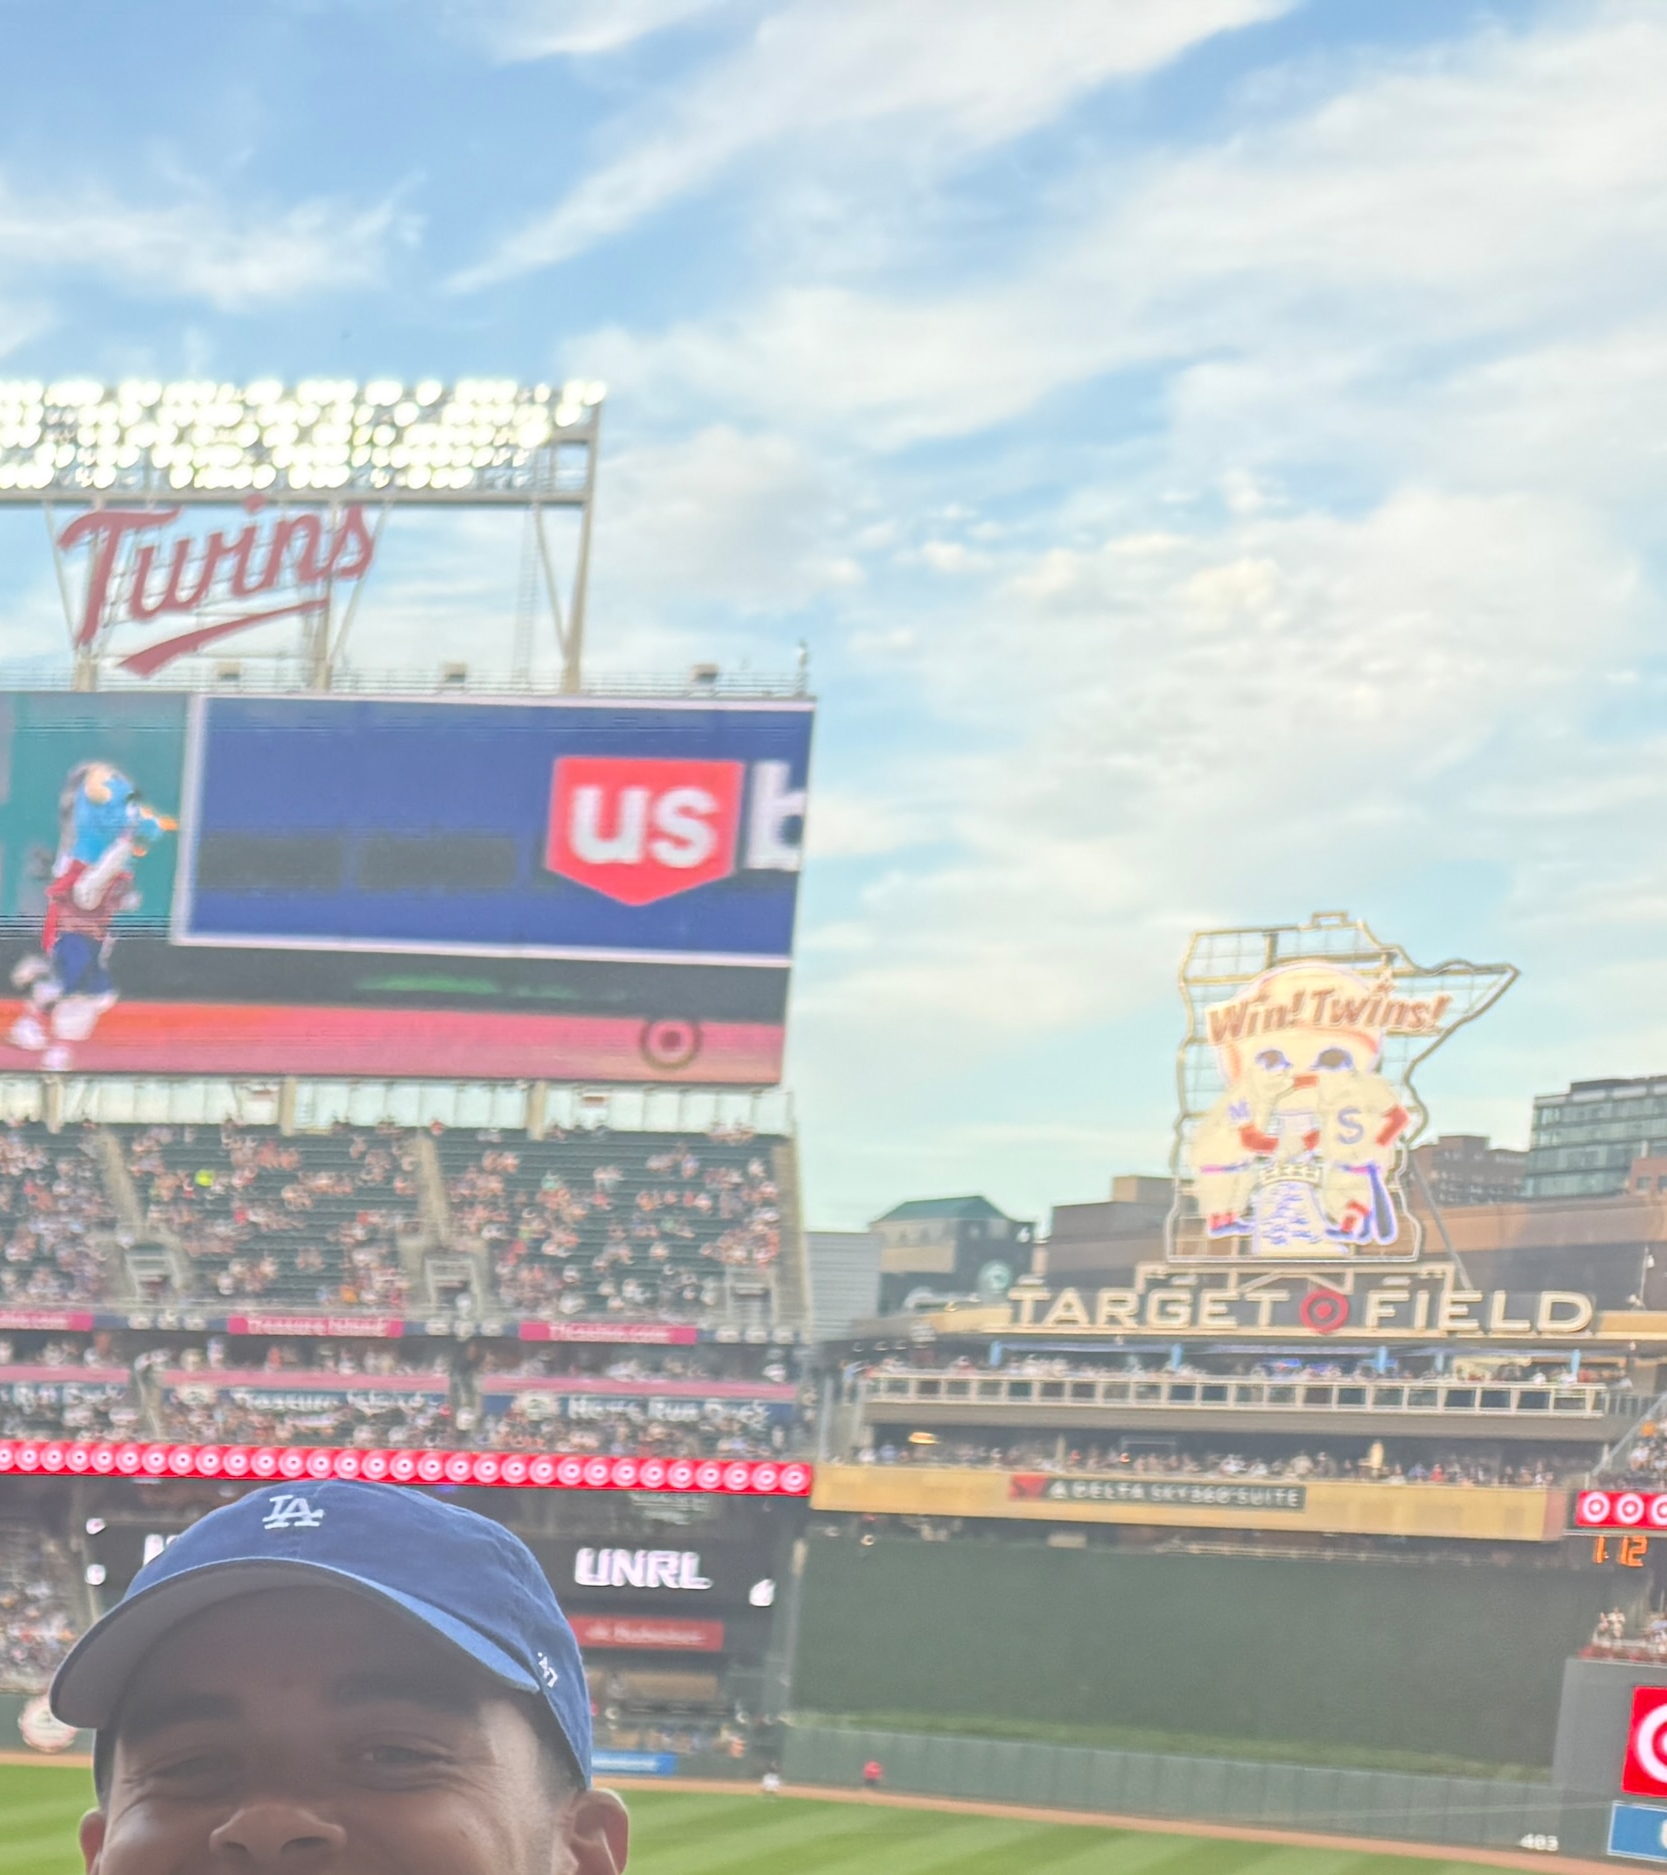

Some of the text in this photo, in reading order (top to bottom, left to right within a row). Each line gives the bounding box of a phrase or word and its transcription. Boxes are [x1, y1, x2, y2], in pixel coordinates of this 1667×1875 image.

[58, 494, 373, 652] Twins
[570, 784, 718, 869] us
[1007, 1287, 1595, 1335] TARGET FIELD
[262, 1494, 324, 1530] LA
[574, 1546, 714, 1591] UNRL
